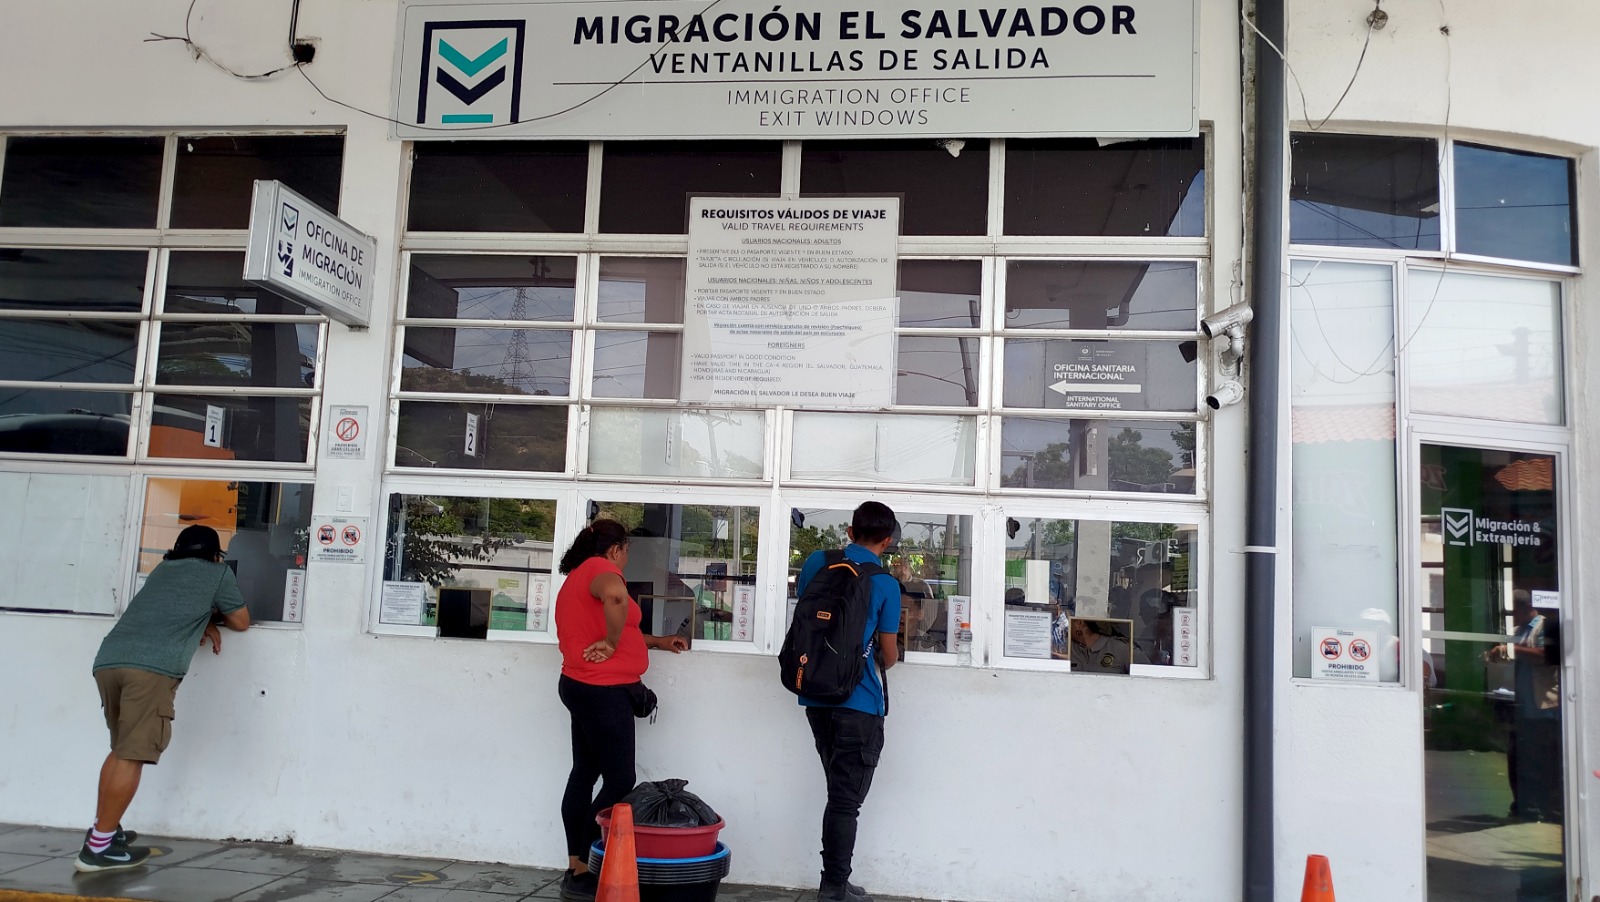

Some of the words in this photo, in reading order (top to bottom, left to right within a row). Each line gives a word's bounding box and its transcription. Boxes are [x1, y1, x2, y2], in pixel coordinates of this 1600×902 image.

[573, 6, 821, 45] MIGRACIÓN
[839, 11, 885, 40] EL
[900, 5, 1137, 39] SALVADOR
[650, 50, 864, 74] VENTANILLAS
[879, 49, 918, 71] DE
[933, 47, 1050, 70] SALIDA
[728, 89, 880, 106] IMMIGRATION
[890, 87, 971, 104] OFFICE
[759, 111, 806, 127] EXIT
[815, 109, 928, 127] WINDOWS
[701, 209, 774, 219] REQUISITOS
[777, 208, 830, 219] VÁLIDOS
[833, 210, 849, 219] DE
[852, 210, 886, 220] VIAJE
[722, 223, 749, 231] VALID
[752, 223, 786, 231] TRAVEL
[789, 223, 864, 231] REQUIREMENTS
[306, 221, 348, 258] OFICINA
[351, 246, 364, 266] DE
[302, 244, 362, 290] MIGRACIÓN
[299, 268, 340, 297] IMMIGRATION
[342, 290, 361, 307] OFFICE
[1054, 364, 1090, 372] OFICINA
[1092, 364, 1136, 373] SANITARIA
[1054, 372, 1124, 380] INTERNACIONAL
[209, 424, 216, 443] 1
[468, 433, 473, 451] 2
[1476, 518, 1530, 532] Migración
[1533, 522, 1541, 533] &
[1476, 531, 1541, 546] Extranjería
